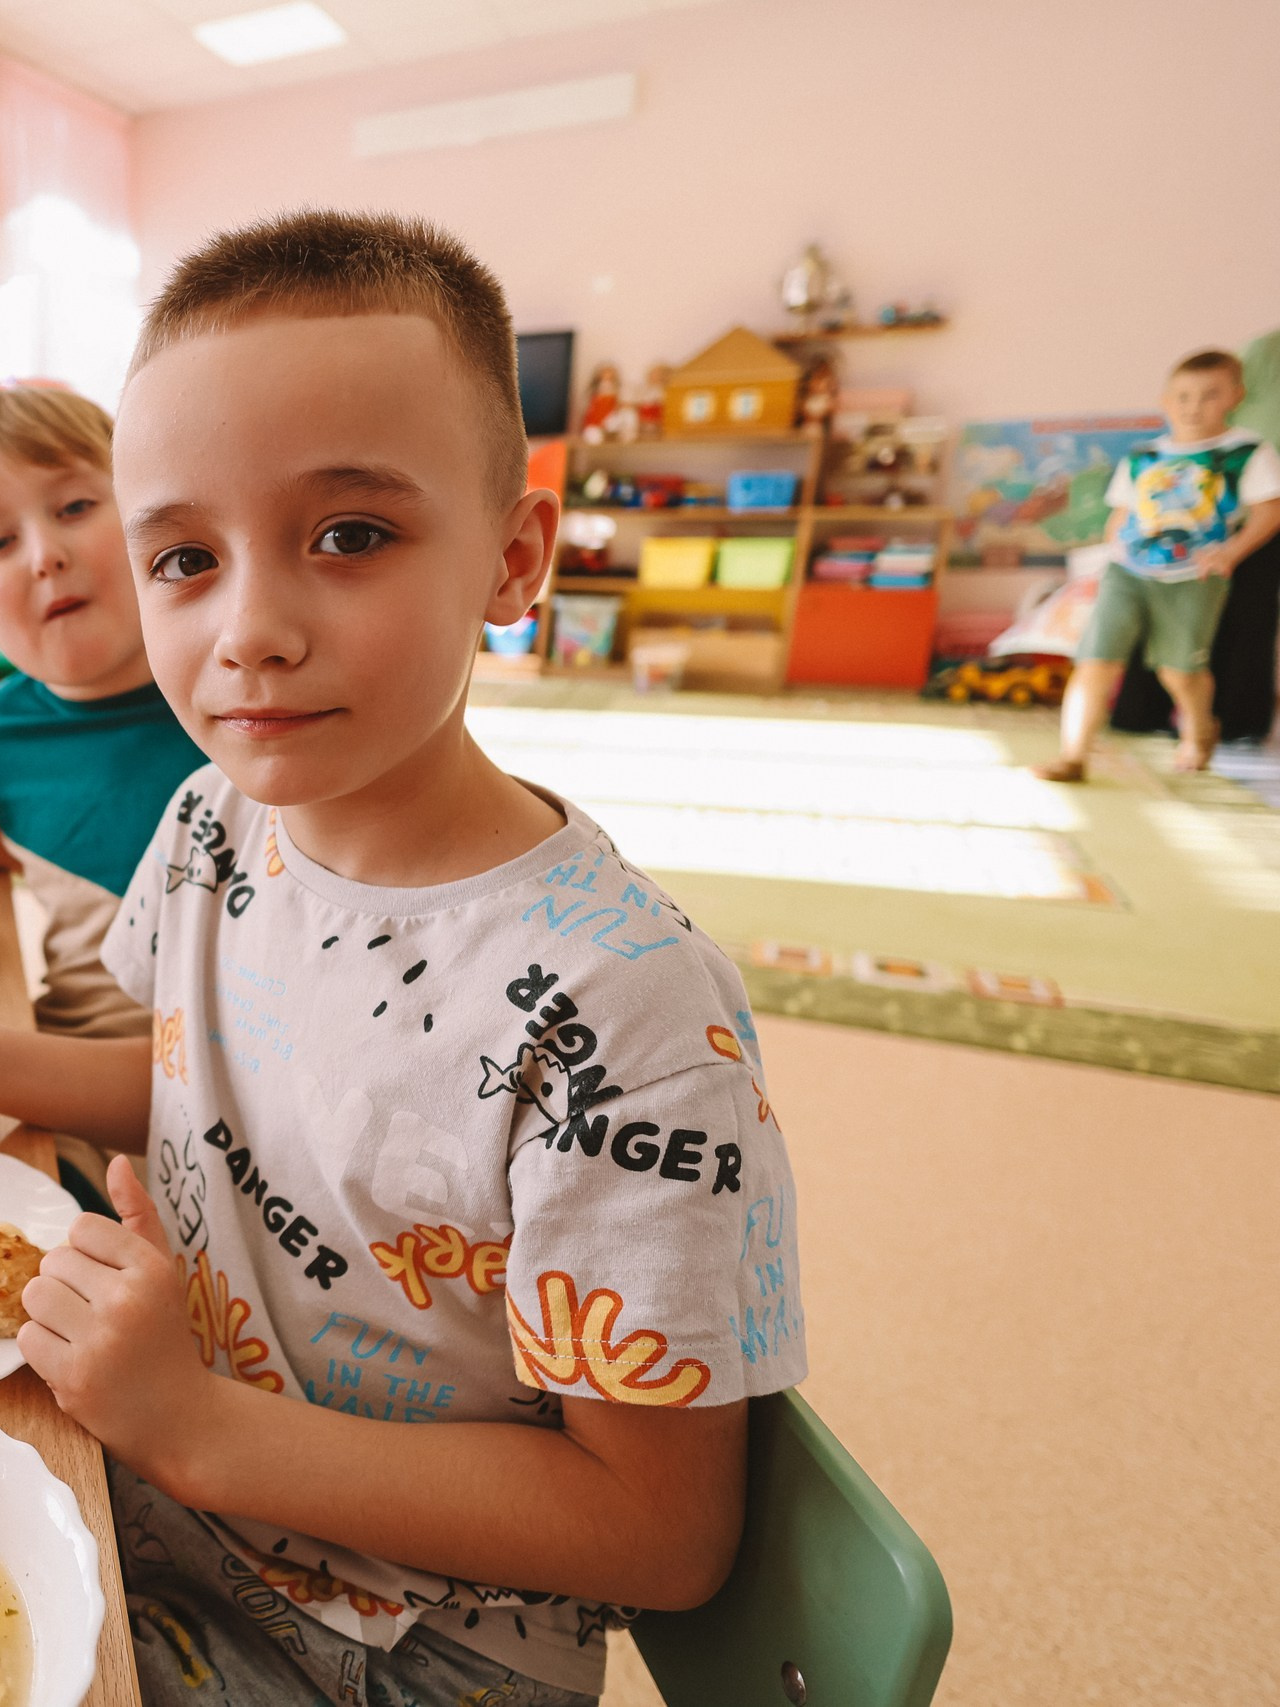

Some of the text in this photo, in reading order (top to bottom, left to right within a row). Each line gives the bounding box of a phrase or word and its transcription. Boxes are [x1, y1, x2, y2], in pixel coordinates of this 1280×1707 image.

[522, 895, 680, 960] FUN
[539, 1111, 741, 1195] NGER
[204, 1117, 348, 1290] DANGER
[176, 1250, 284, 1394] AVE
[310, 1312, 432, 1365] FUN
[728, 1296, 798, 1364] WA
[327, 1359, 456, 1408] IN THE
